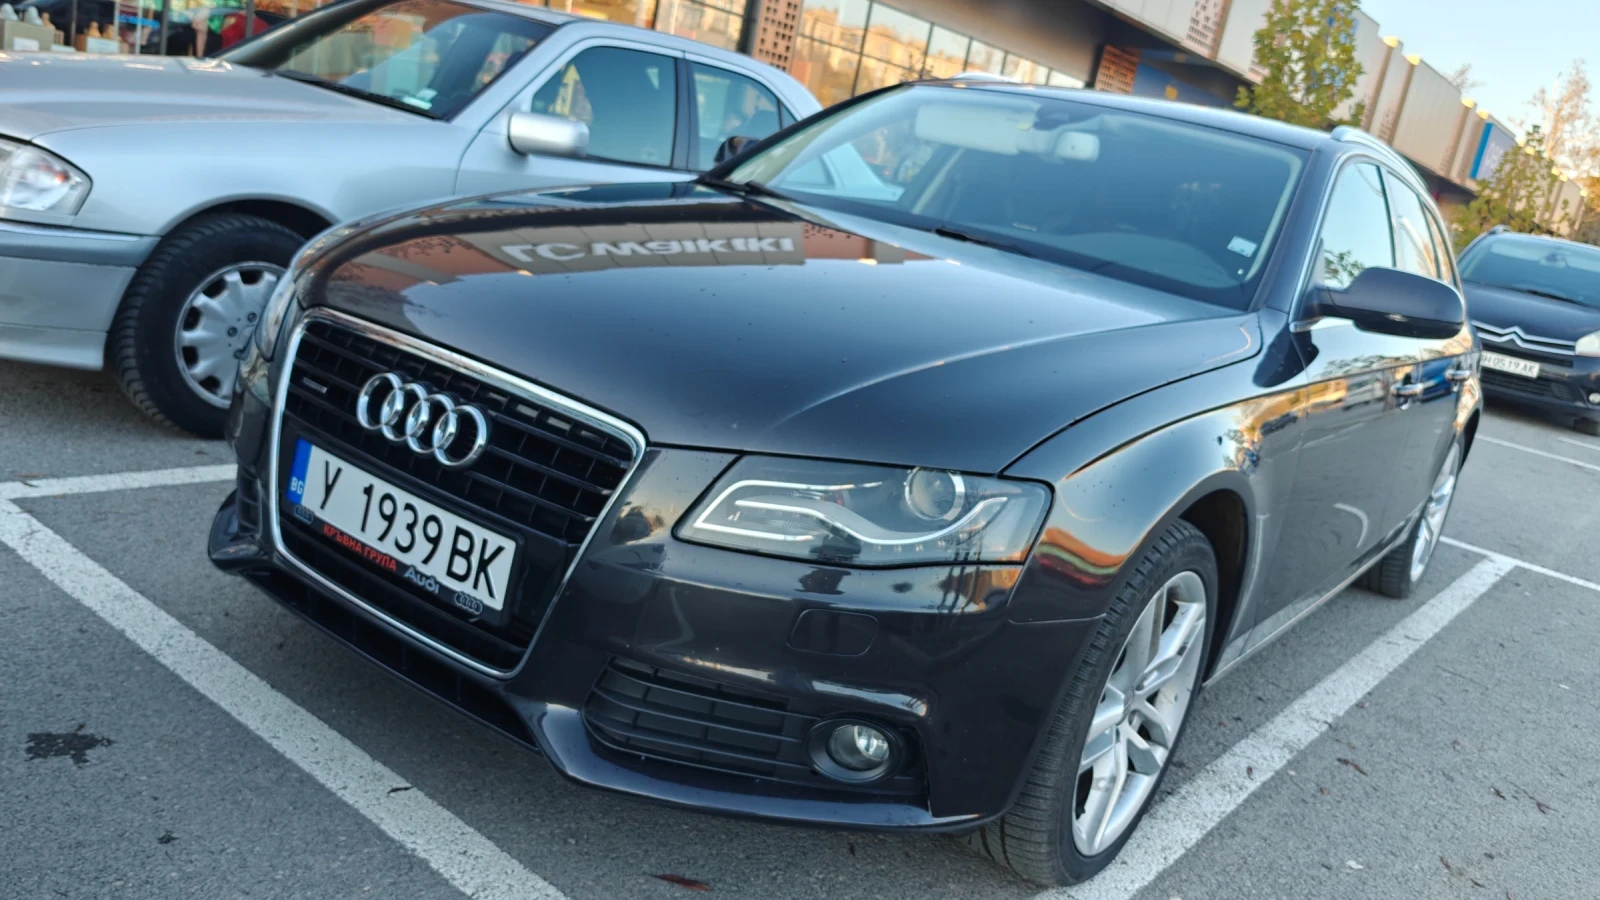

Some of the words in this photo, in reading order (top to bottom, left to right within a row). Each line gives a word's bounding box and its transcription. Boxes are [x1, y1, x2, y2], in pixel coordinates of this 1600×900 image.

[290, 476, 304, 495] BG
[323, 523, 362, 552] КРЪВНА
[363, 545, 397, 572] ГРУПА
[361, 482, 444, 566] 1939
[446, 524, 506, 600] BK
[404, 565, 440, 595] Audi
